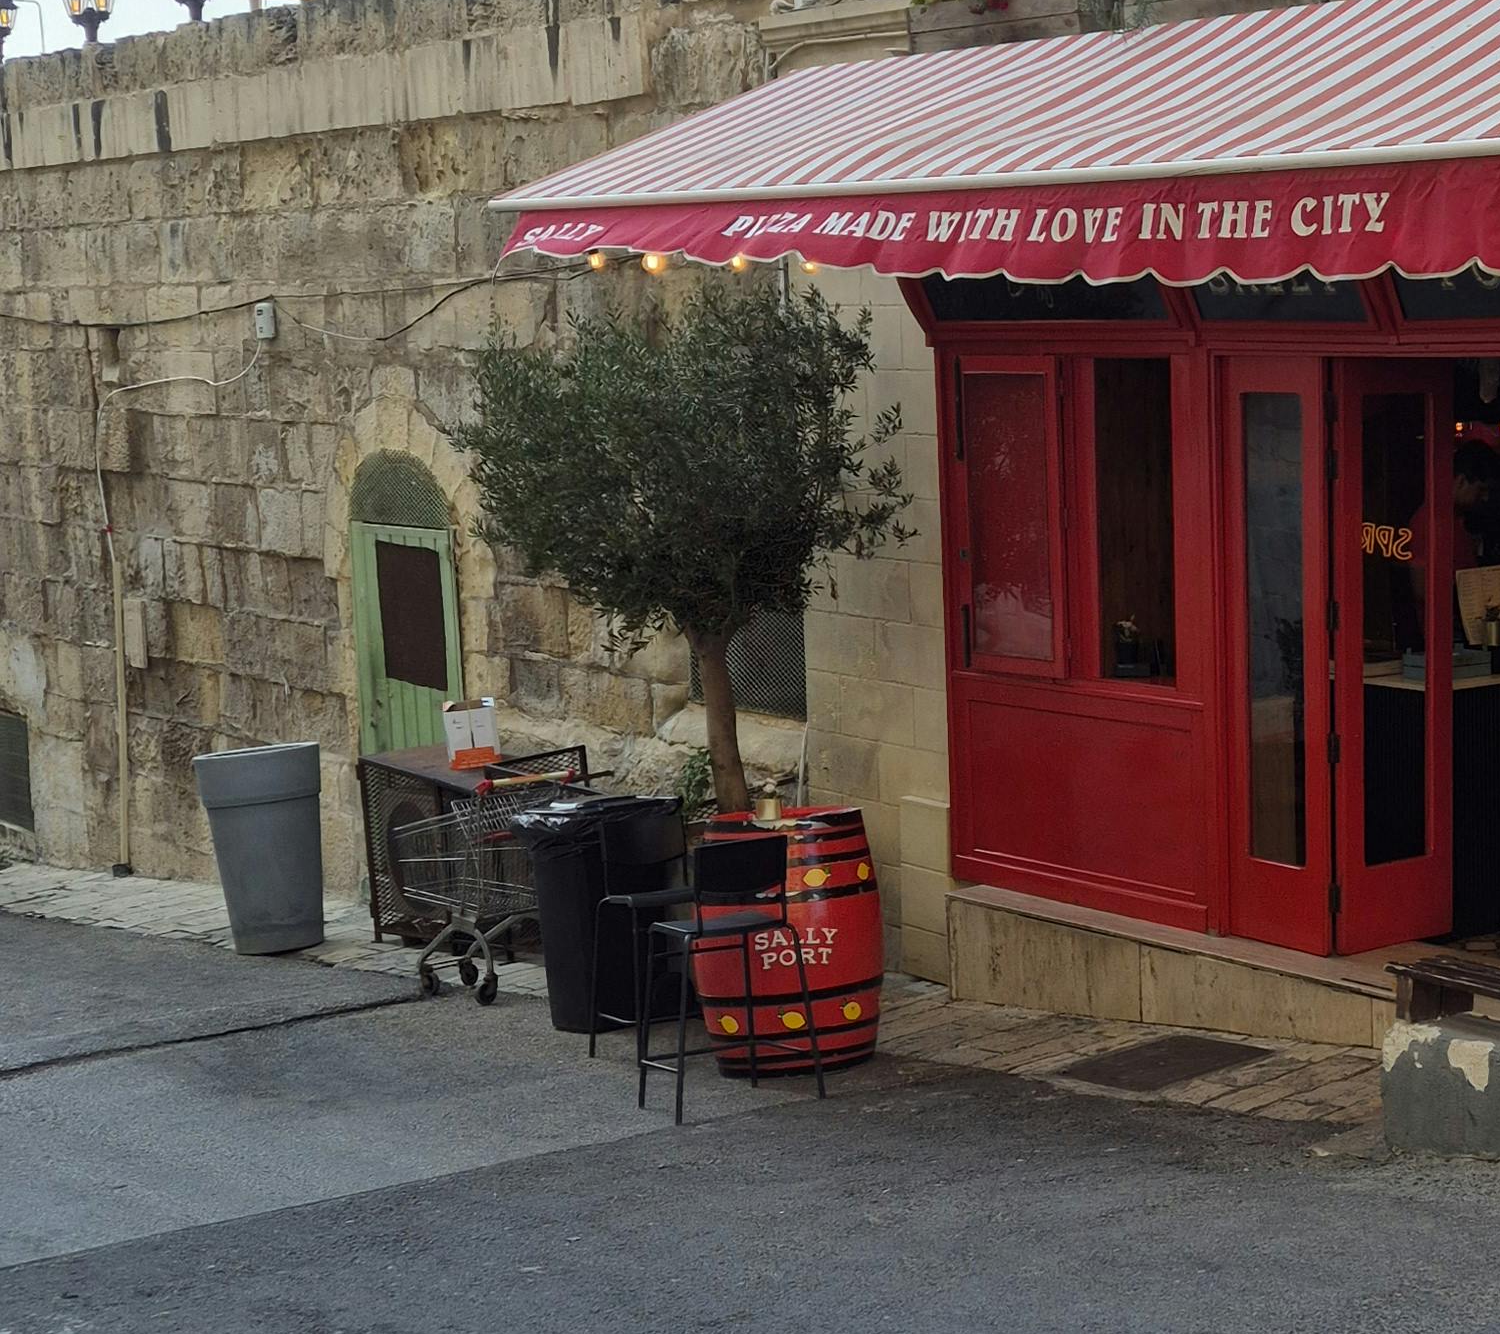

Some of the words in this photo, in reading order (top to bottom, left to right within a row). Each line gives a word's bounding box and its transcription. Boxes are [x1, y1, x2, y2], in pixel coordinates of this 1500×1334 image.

[721, 211, 812, 238] PIZZA
[812, 209, 914, 242] MADE
[926, 206, 1020, 242] WITH
[1027, 206, 1123, 244] LOVE
[1138, 202, 1185, 241] IN
[1197, 199, 1273, 240] THE
[1291, 192, 1390, 236] CITY
[517, 222, 604, 248] SALLY
[761, 947, 832, 970] PORT
